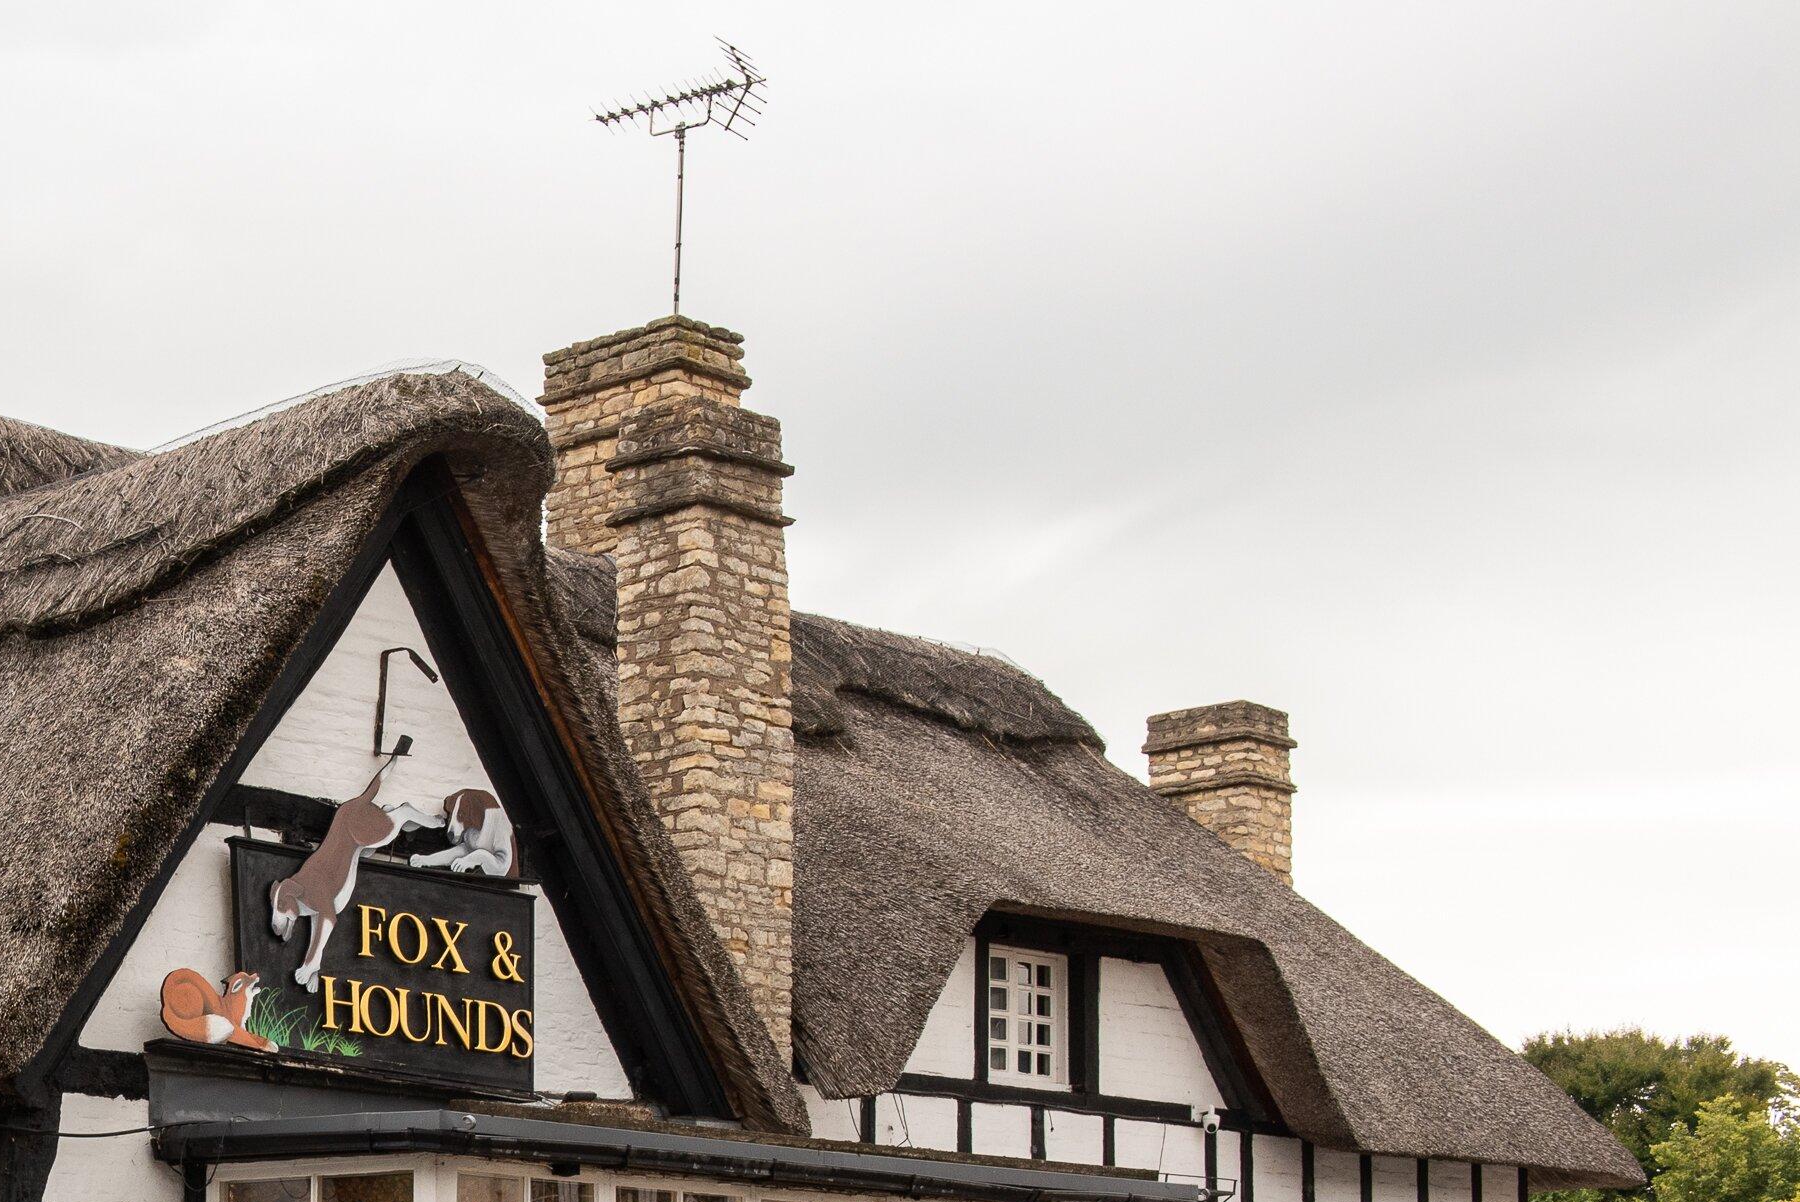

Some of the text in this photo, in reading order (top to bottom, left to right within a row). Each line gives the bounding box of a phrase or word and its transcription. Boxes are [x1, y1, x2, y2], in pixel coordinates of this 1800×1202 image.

[357, 904, 525, 983] FOX &
[321, 975, 533, 1059] HOUNDS
